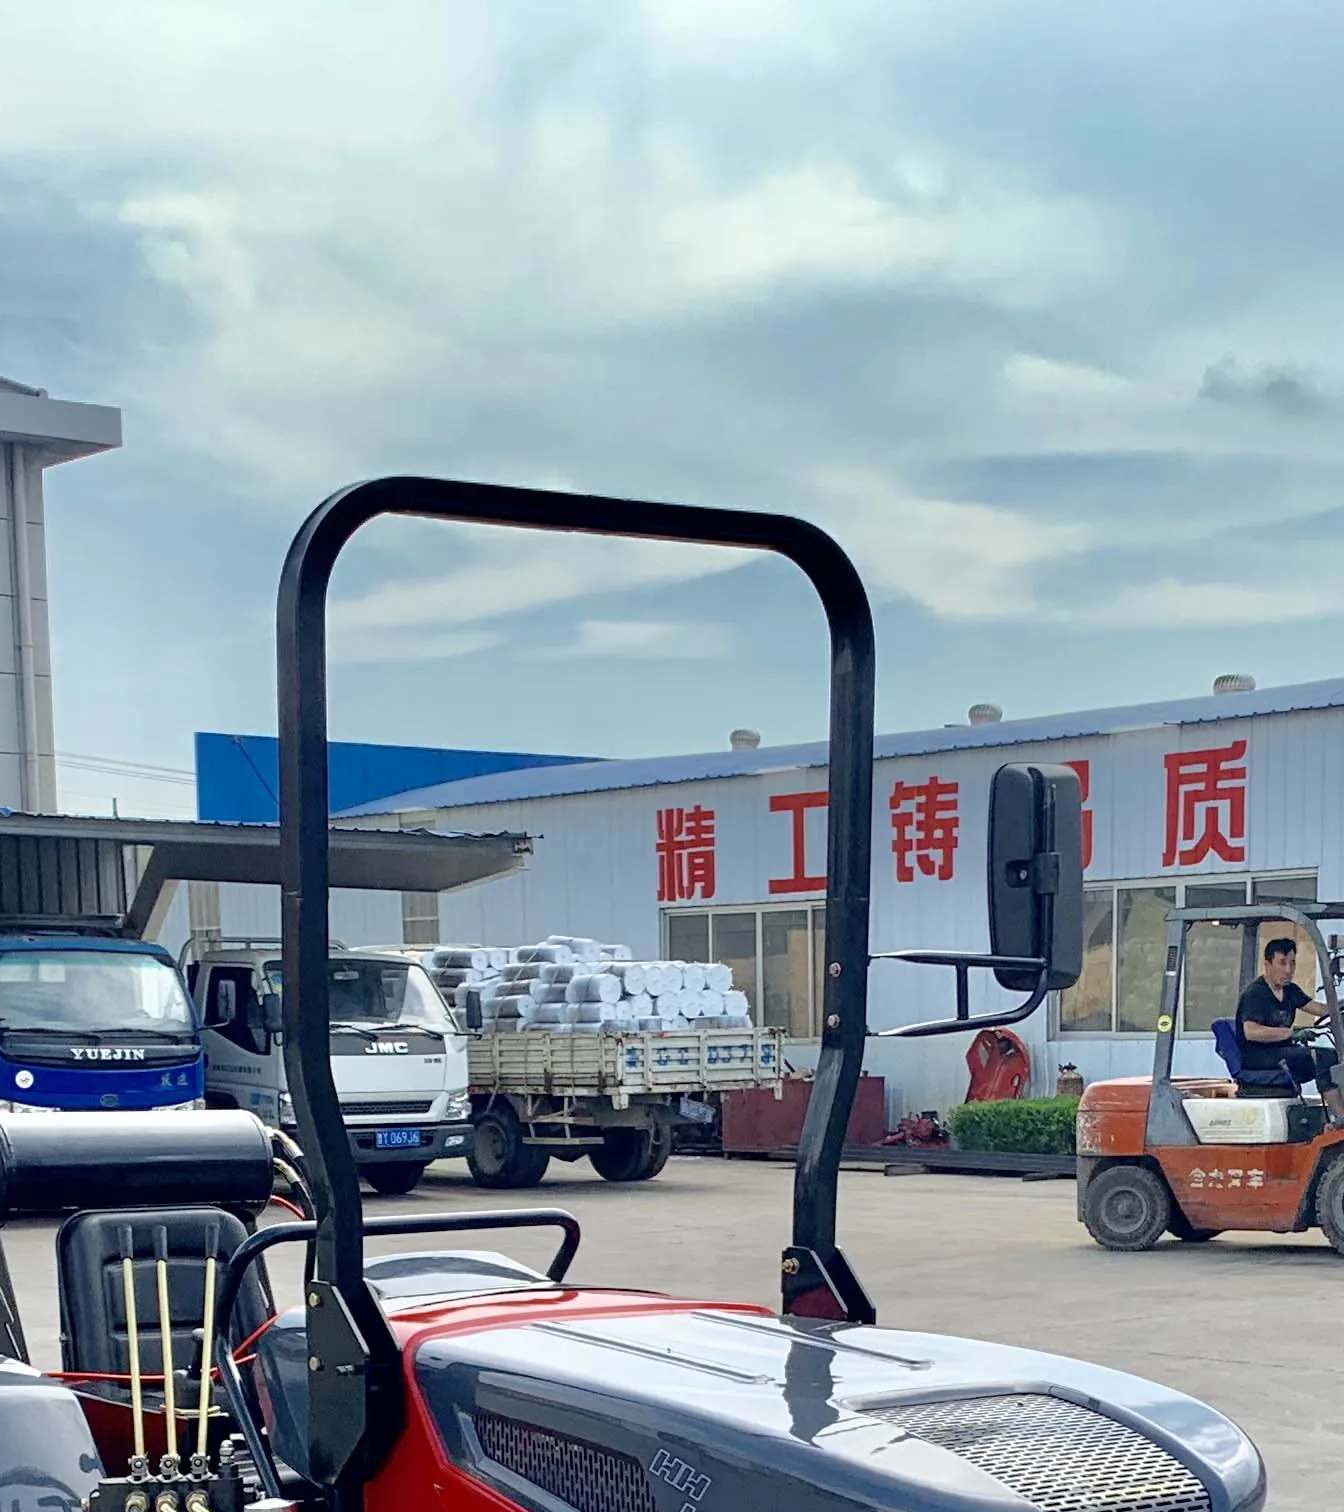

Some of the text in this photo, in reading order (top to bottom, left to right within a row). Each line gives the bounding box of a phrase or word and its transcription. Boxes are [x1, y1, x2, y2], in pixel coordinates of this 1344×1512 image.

[656, 739, 1248, 903] 精工铸质
[70, 1048, 145, 1060] YUEJIN
[364, 1042, 409, 1054] JMC
[649, 1448, 712, 1501] HH
